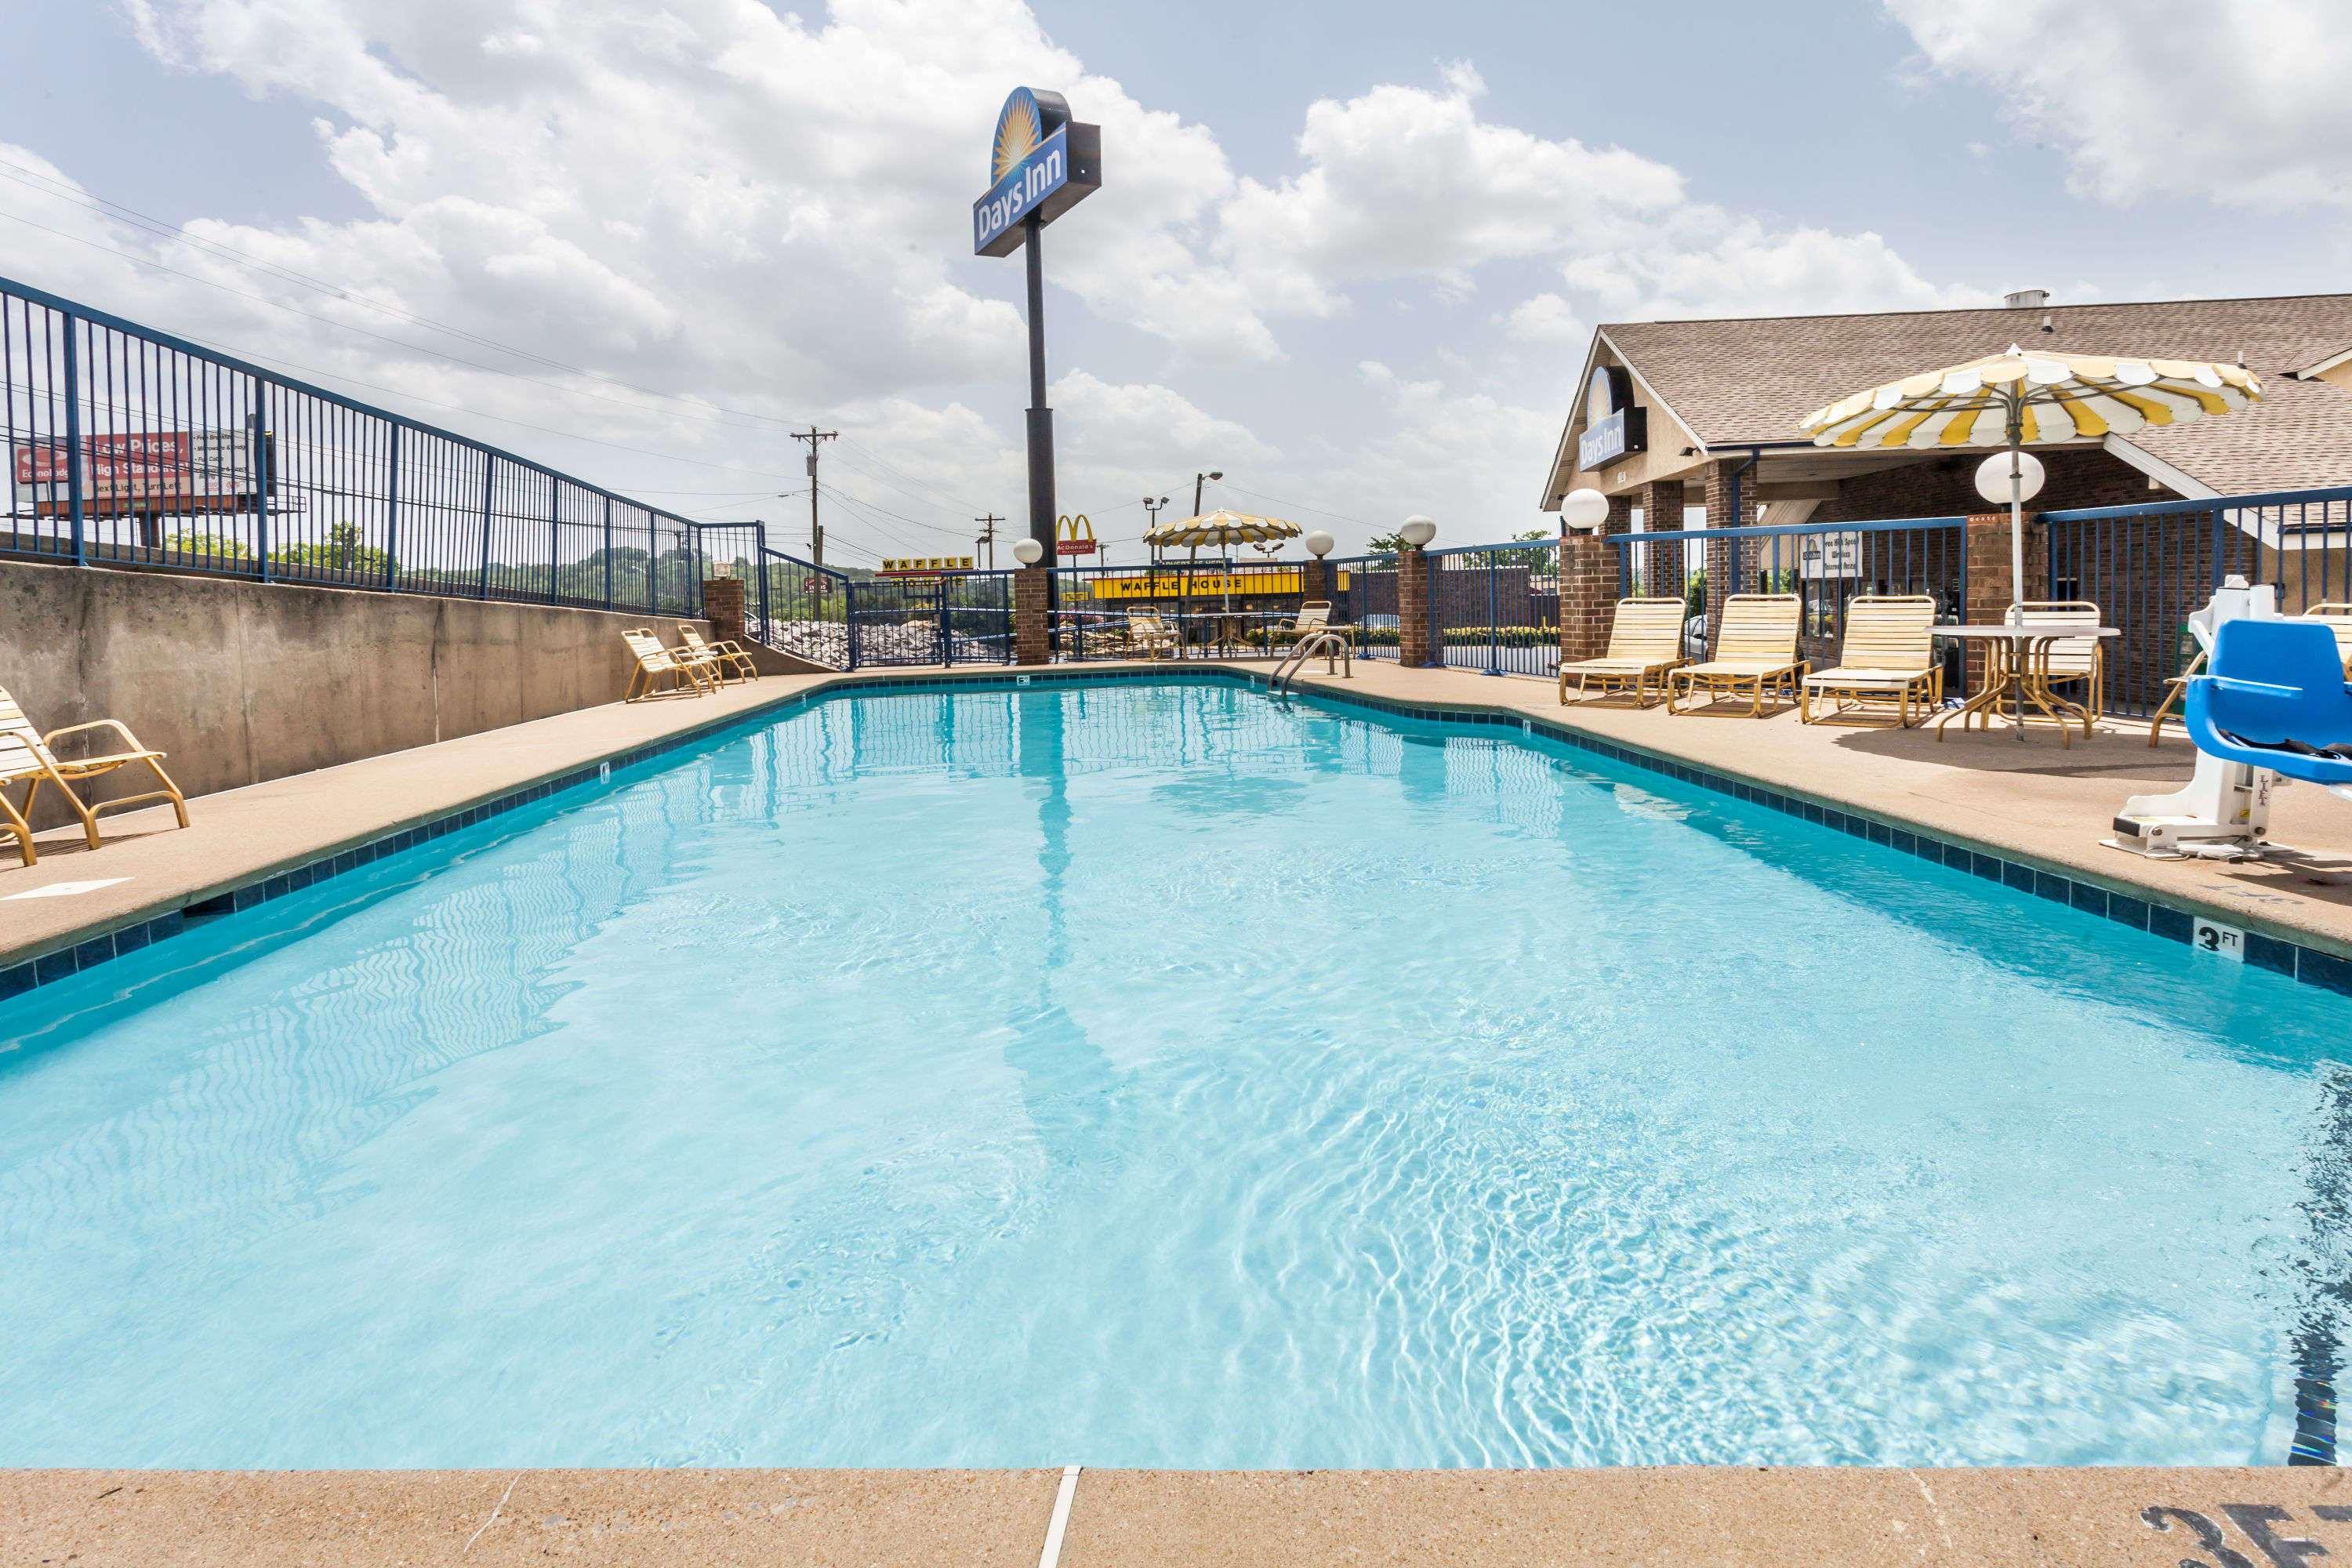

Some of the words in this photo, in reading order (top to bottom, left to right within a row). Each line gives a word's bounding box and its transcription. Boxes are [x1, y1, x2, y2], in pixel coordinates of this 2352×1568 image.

[979, 181, 1022, 241] Days
[1025, 149, 1062, 203] Inn
[1581, 435, 1603, 464] Days
[1604, 426, 1622, 454] Inn
[21, 468, 70, 480] EcnoLdg
[122, 461, 189, 475] Stadds!
[115, 483, 141, 494] Ligt,
[883, 557, 971, 569] WAFFLE
[1120, 581, 1179, 592] WAFFLE
[1191, 579, 1242, 589] HOUSE
[2198, 926, 2220, 952] 3
[2222, 931, 2238, 947] FT
[2140, 1504, 2352, 1568] 3F
